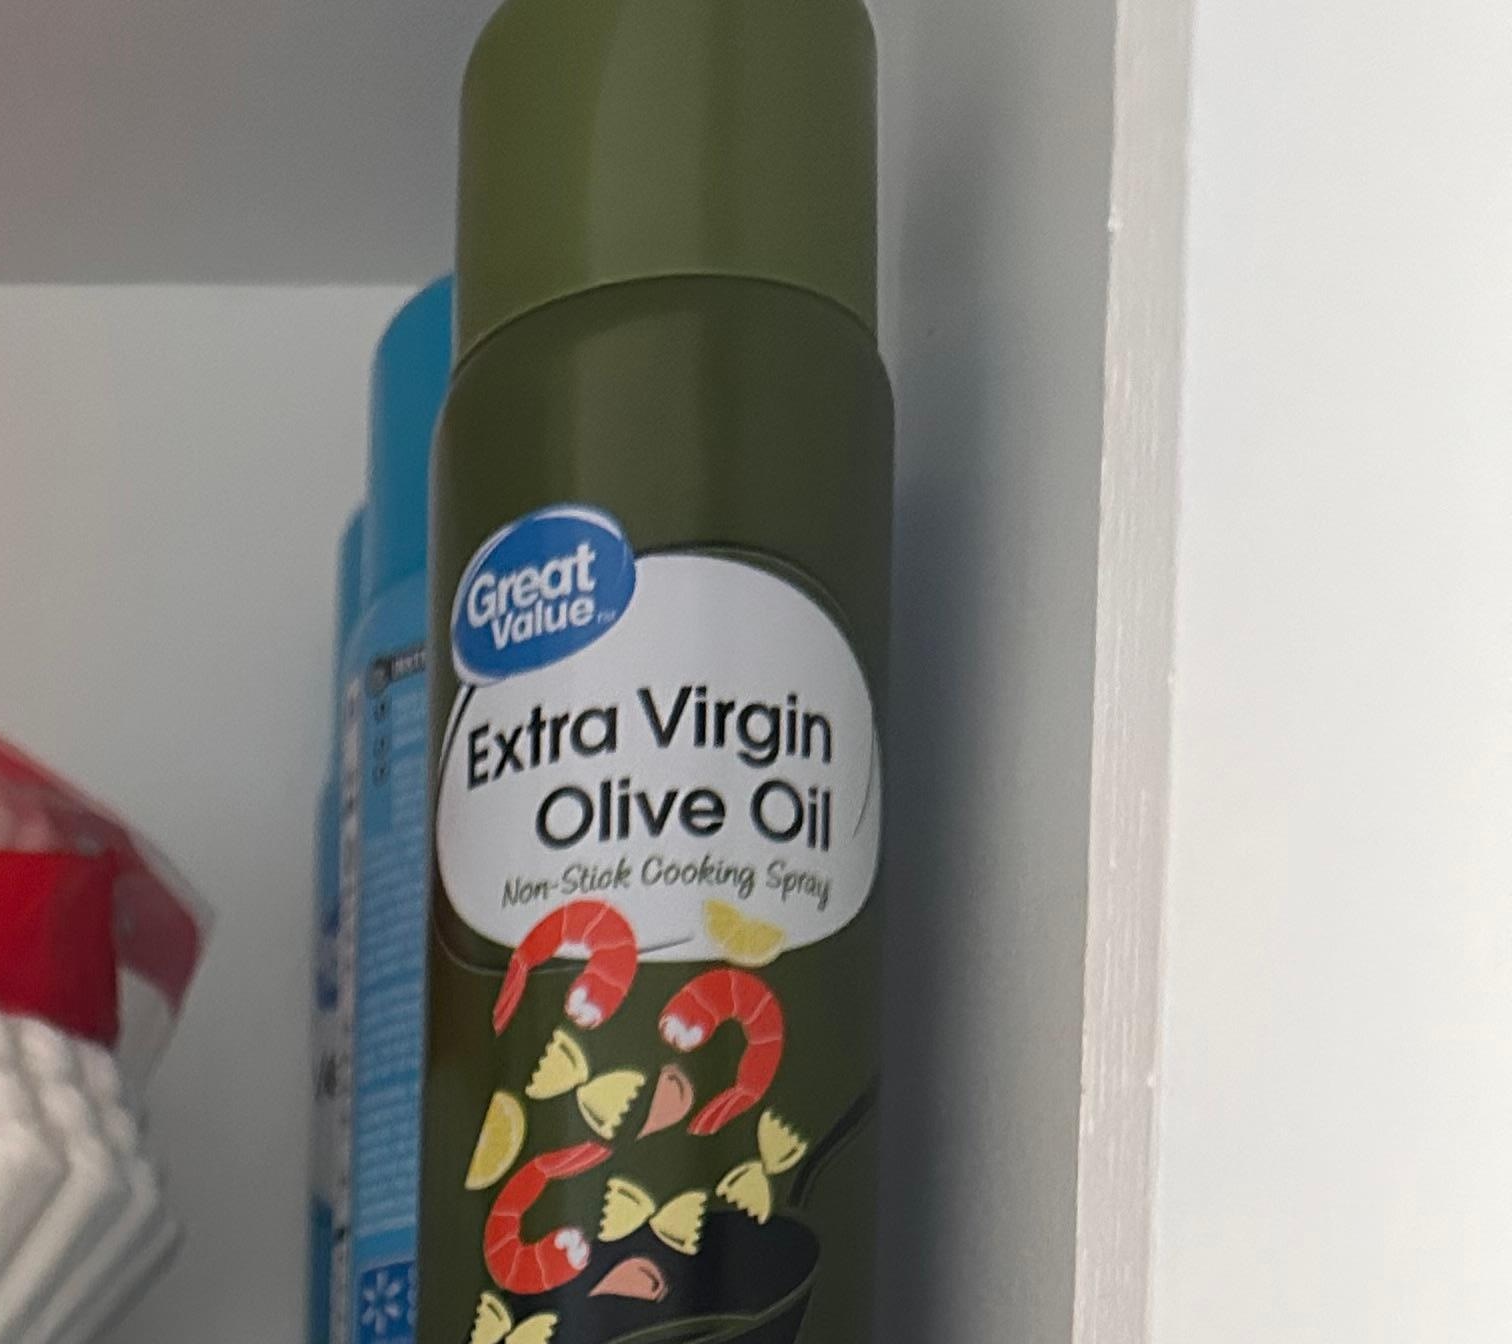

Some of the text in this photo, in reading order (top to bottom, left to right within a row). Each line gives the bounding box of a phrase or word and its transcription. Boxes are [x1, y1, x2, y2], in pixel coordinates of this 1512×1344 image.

[467, 542, 595, 628] Great
[491, 596, 594, 651] Value
[467, 684, 831, 789] Extra Virgin
[535, 777, 830, 852] Olive Oil
[501, 853, 831, 911] Non-Stick Cooking Spray
